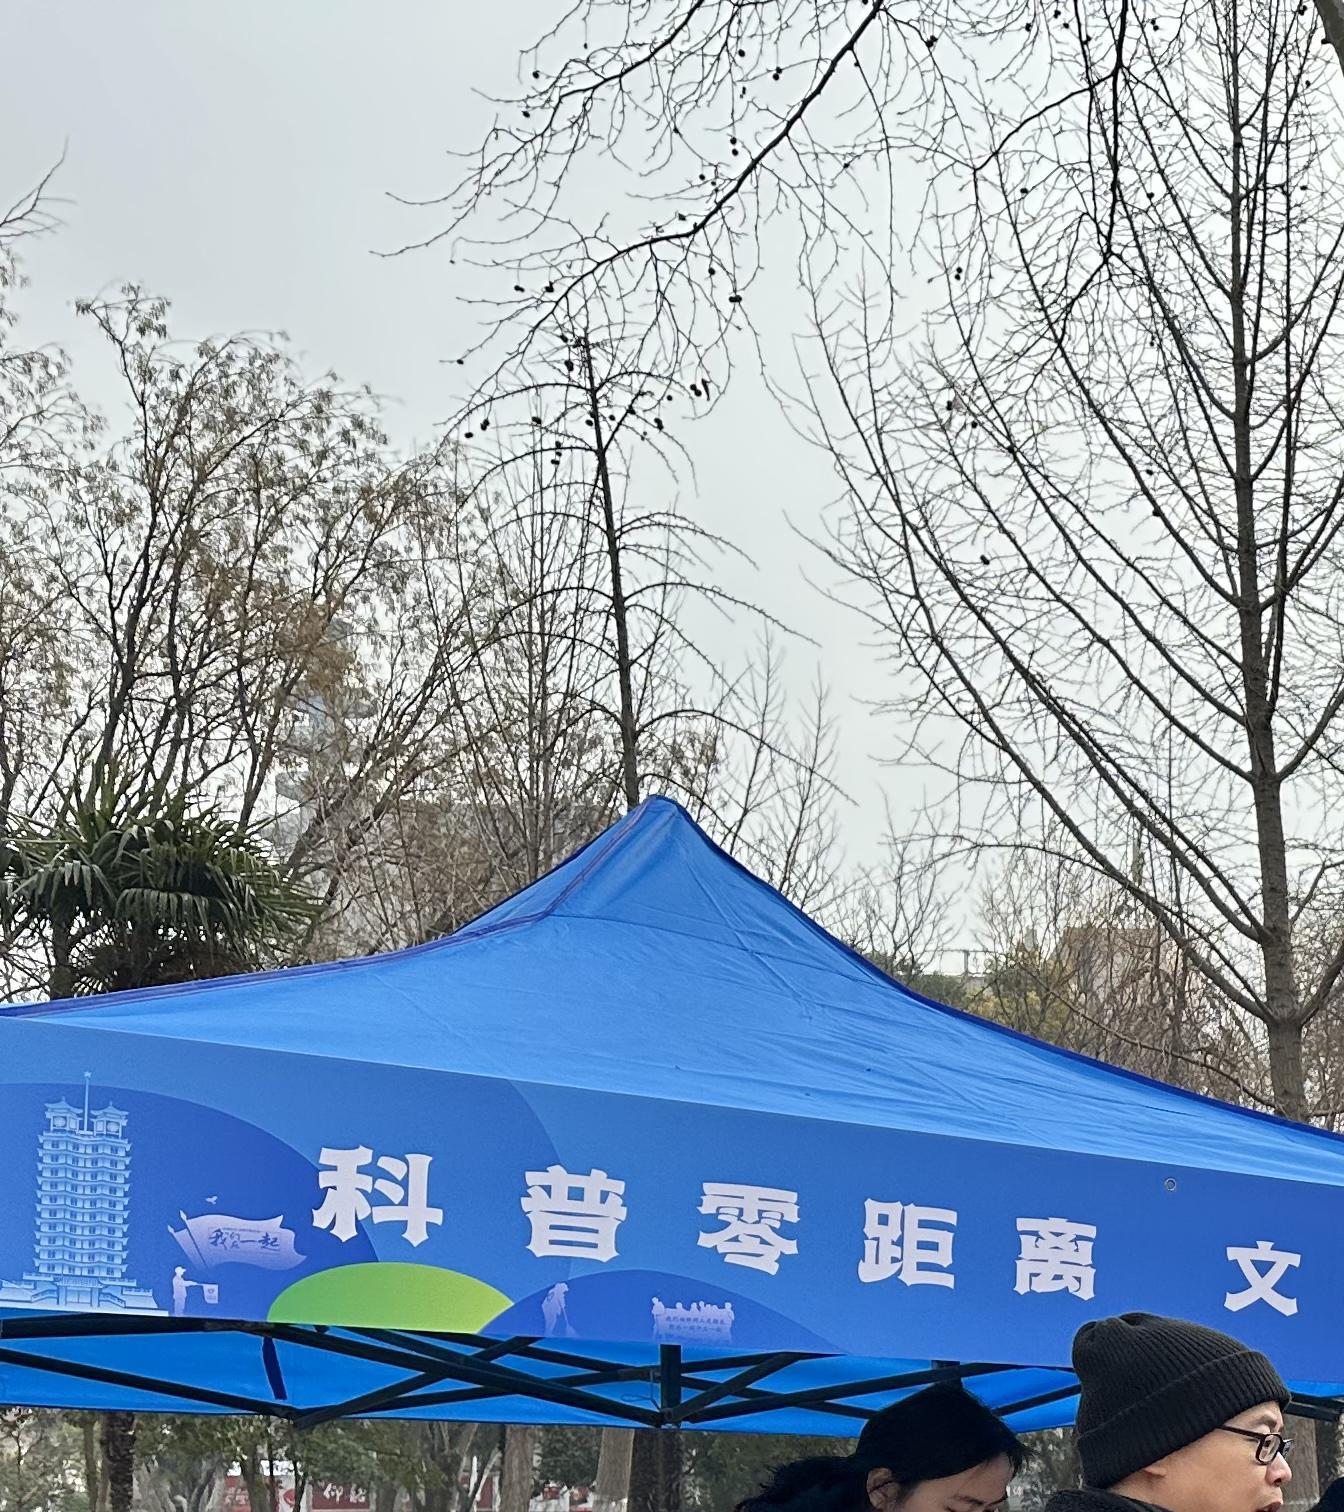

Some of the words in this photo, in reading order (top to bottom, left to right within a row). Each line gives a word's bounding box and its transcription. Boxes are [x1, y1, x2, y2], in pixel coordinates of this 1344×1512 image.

[312, 1145, 1098, 1300] 科普零距离
